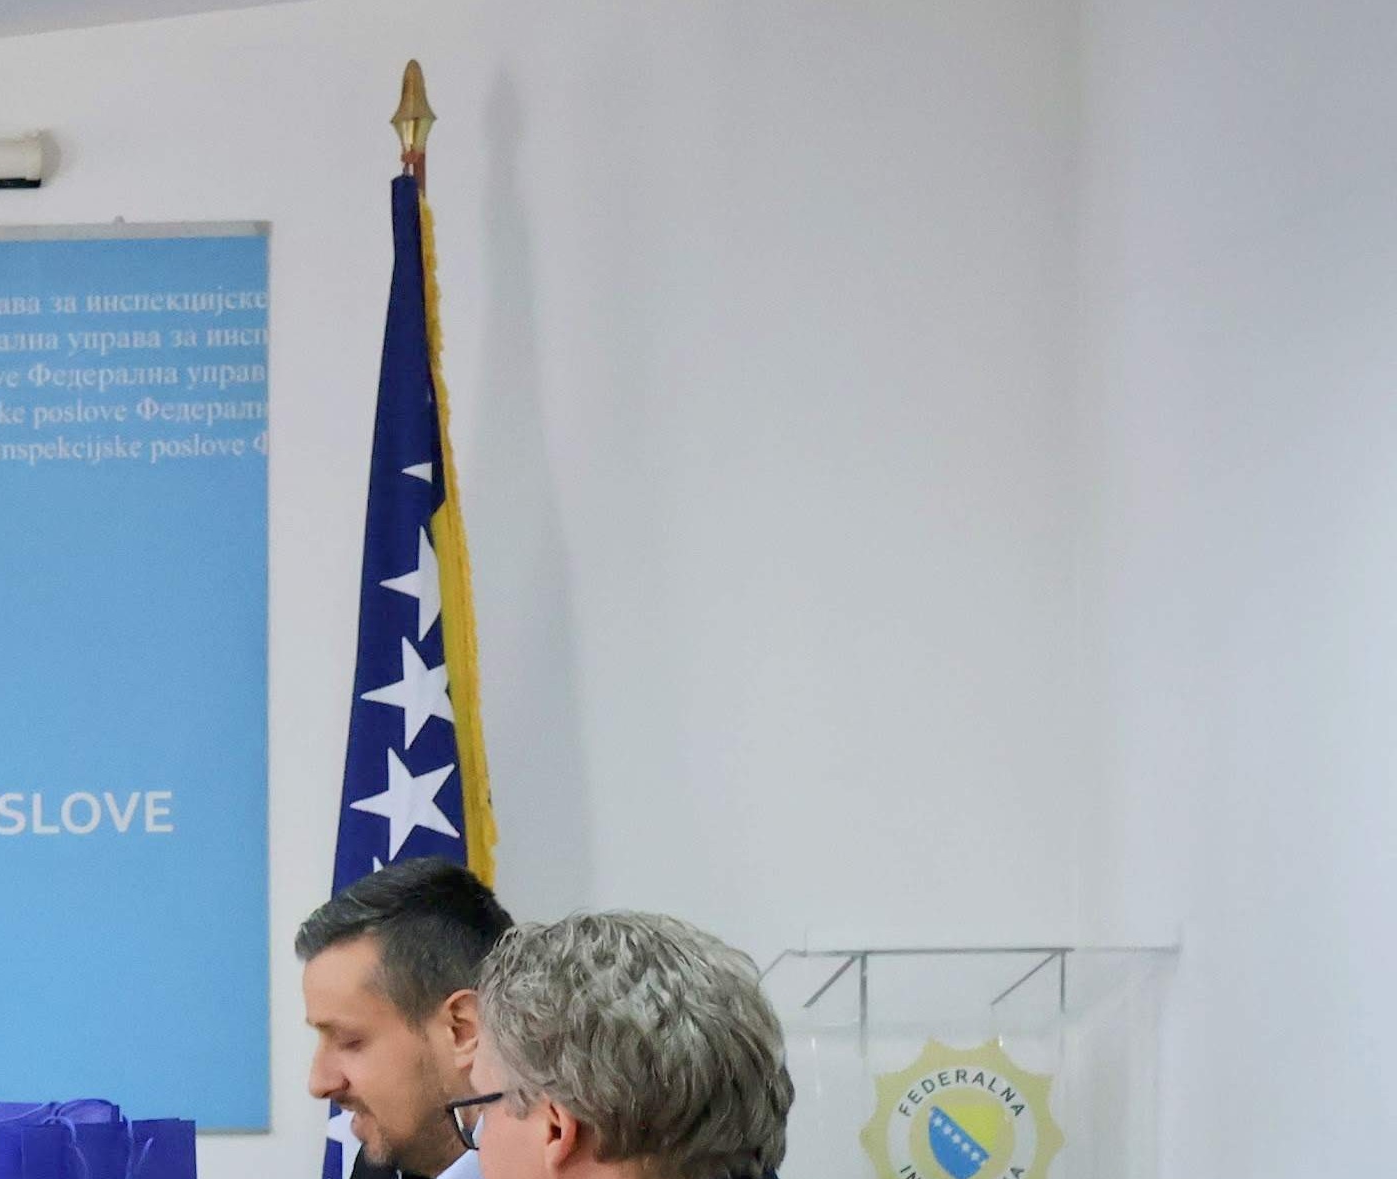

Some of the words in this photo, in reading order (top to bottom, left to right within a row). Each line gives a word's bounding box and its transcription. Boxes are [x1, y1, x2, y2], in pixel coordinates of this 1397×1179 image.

[50, 294, 78, 315] за
[67, 330, 162, 357] управа
[171, 329, 198, 348] за
[26, 362, 179, 393] Федерална
[32, 398, 128, 430] poslove
[149, 433, 246, 465] poslove
[898, 1068, 1025, 1117] FEDERALNA
